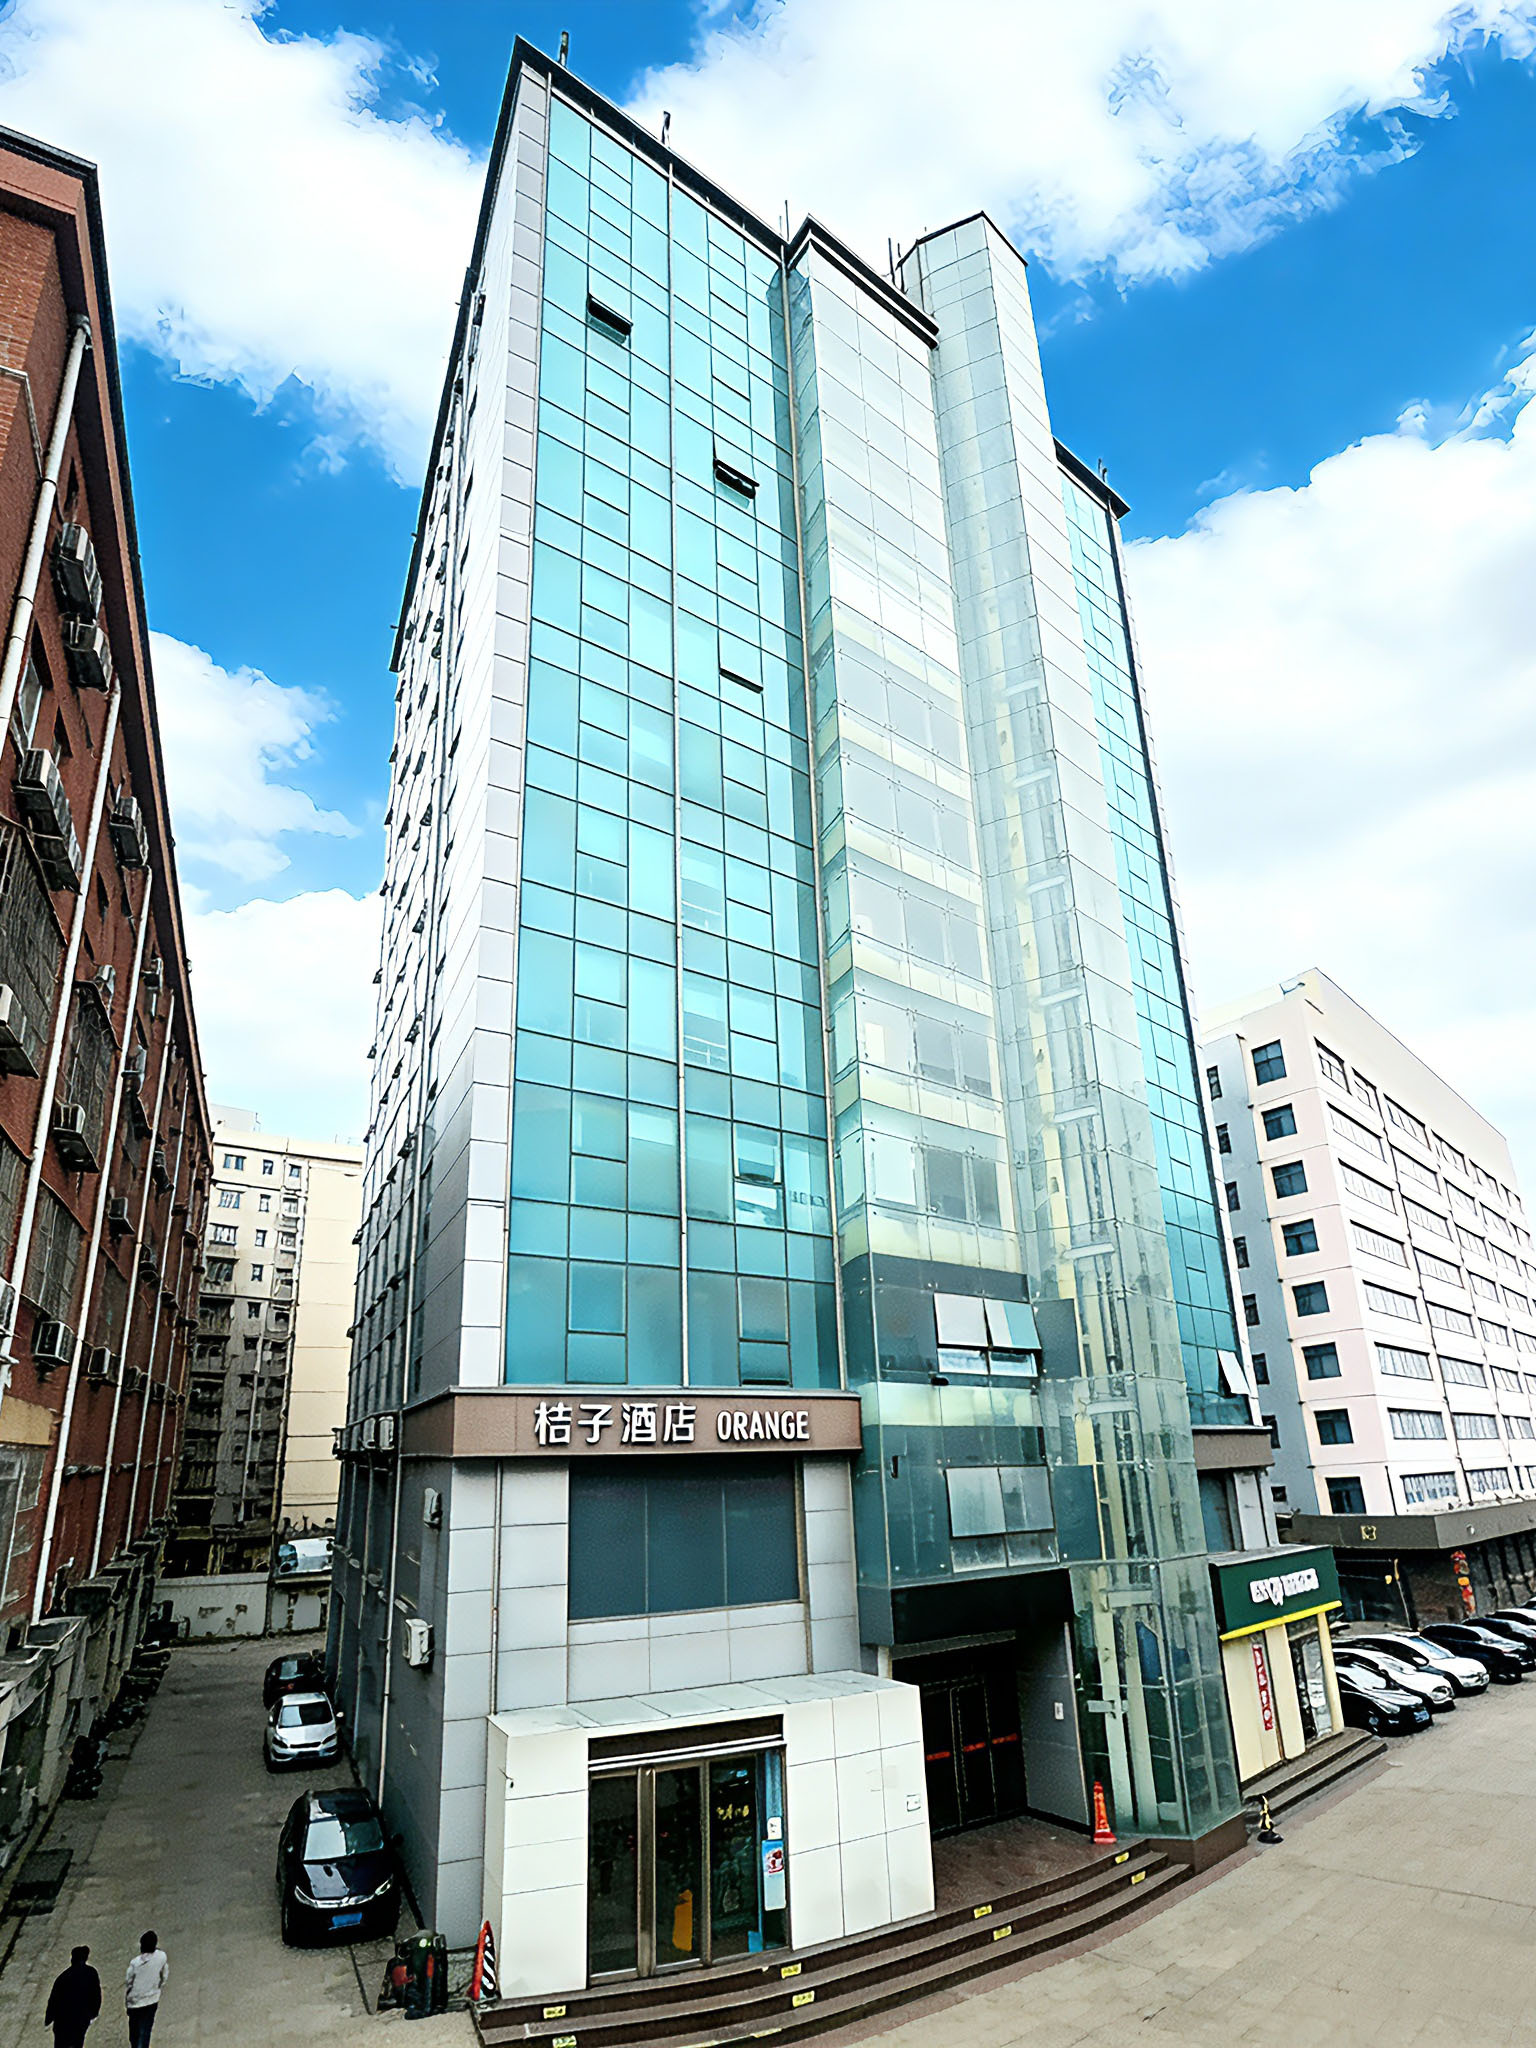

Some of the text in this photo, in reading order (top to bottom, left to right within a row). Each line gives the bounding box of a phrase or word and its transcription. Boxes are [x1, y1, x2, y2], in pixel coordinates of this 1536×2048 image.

[534, 1401, 697, 1445] 桔子酒店
[717, 1411, 811, 1441] ORANGE
